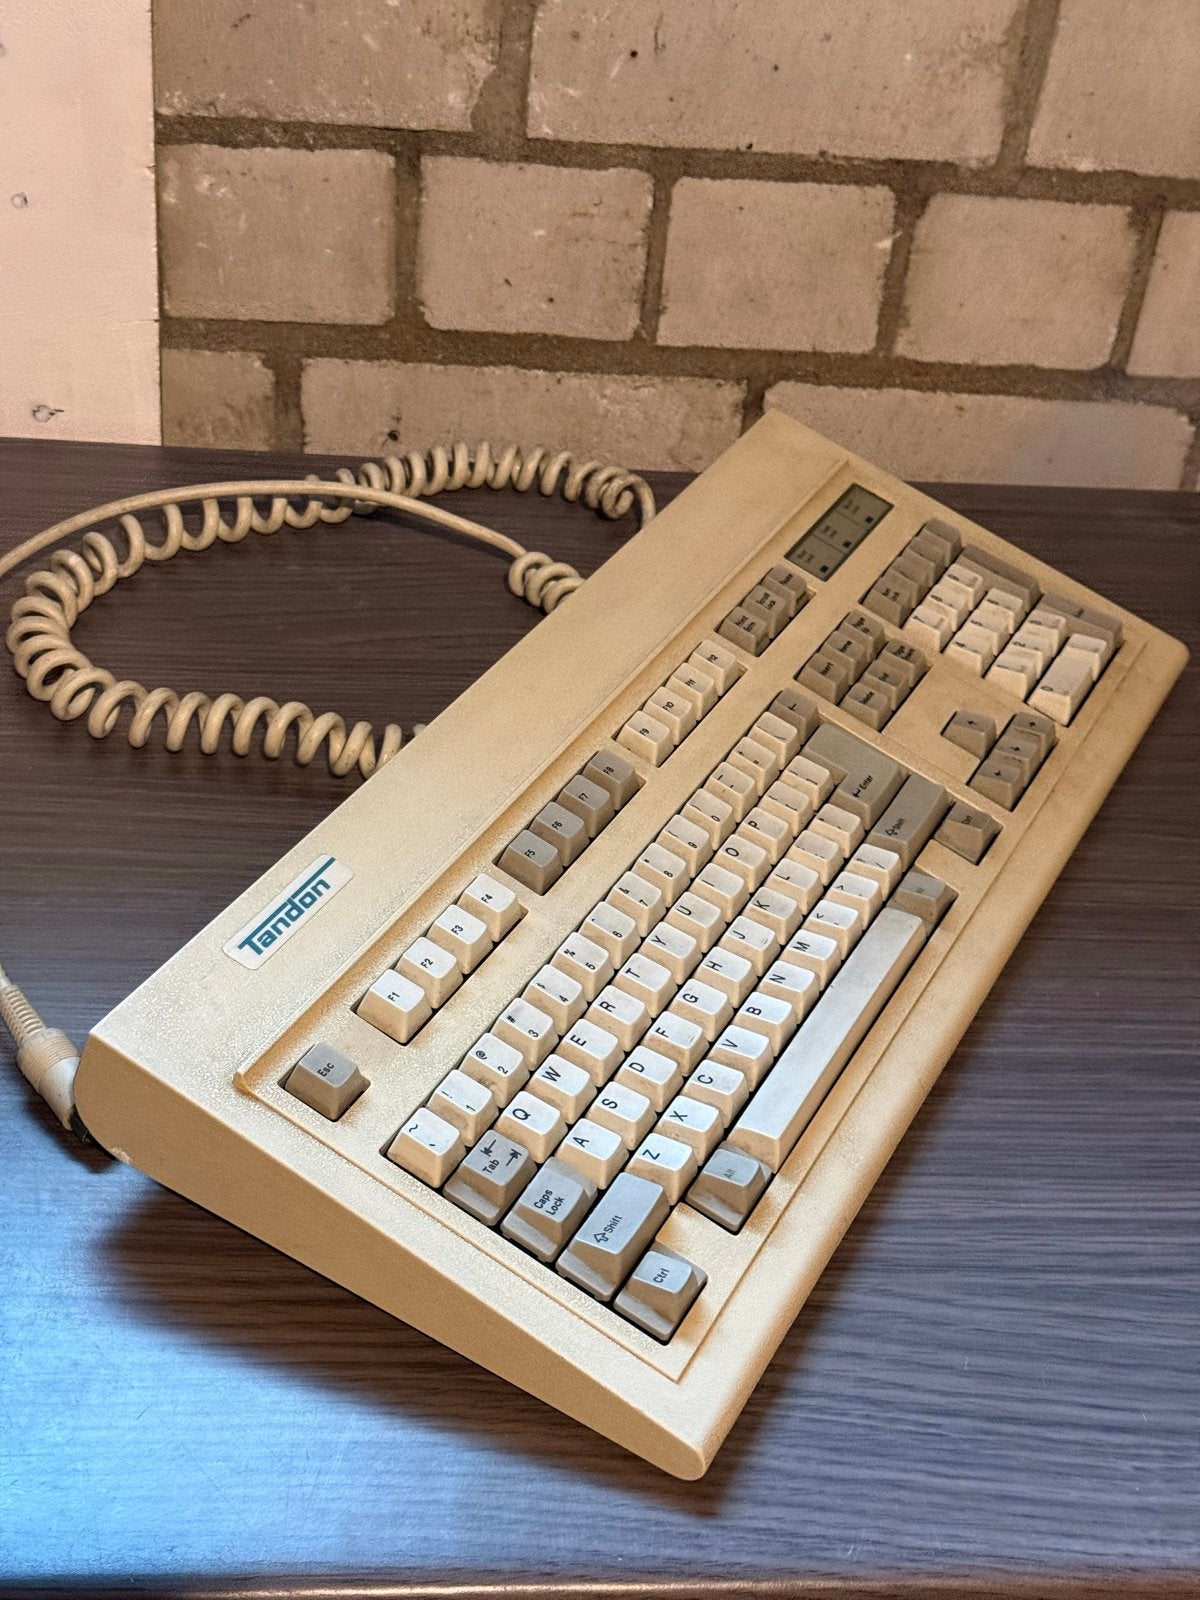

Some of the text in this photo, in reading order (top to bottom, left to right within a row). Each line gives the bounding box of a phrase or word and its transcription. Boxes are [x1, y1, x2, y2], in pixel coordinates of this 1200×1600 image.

[662, 702, 674, 712] F10
[603, 766, 614, 775] F8
[859, 774, 874, 790] Enter
[578, 792, 588, 801] F7
[552, 821, 562, 830] F6
[748, 821, 760, 830] P
[524, 849, 536, 858] F5
[481, 894, 493, 903] F4
[237, 857, 336, 955] Tandon
[676, 905, 692, 916] U
[754, 900, 770, 910] K
[451, 925, 464, 934] F3
[733, 930, 746, 940] J
[651, 935, 666, 946] Y
[793, 941, 810, 952] M
[420, 958, 434, 969] F2
[585, 962, 596, 970] 5
[706, 960, 722, 972] H
[626, 968, 640, 978] T
[769, 974, 786, 984] N
[388, 992, 400, 1002] F1
[682, 993, 699, 1004] G
[599, 1001, 616, 1012] R
[746, 1006, 762, 1016] B
[528, 1030, 538, 1038] 3
[655, 1026, 670, 1038] F
[570, 1034, 587, 1046] E
[722, 1038, 738, 1049] V
[476, 1050, 488, 1060] @
[318, 1062, 334, 1078] Esc
[498, 1066, 508, 1074] 2
[628, 1062, 645, 1073] D
[542, 1066, 562, 1082] W
[697, 1074, 714, 1085] C
[602, 1098, 618, 1109] S
[512, 1108, 531, 1120] Q
[670, 1110, 688, 1122] X
[572, 1135, 590, 1148] A
[642, 1149, 660, 1160] Z
[482, 1160, 500, 1174] Tab
[534, 1189, 553, 1210] Caps
[545, 1196, 565, 1216] Lock
[604, 1214, 622, 1234] Shift
[654, 1268, 670, 1284] Ctrl
